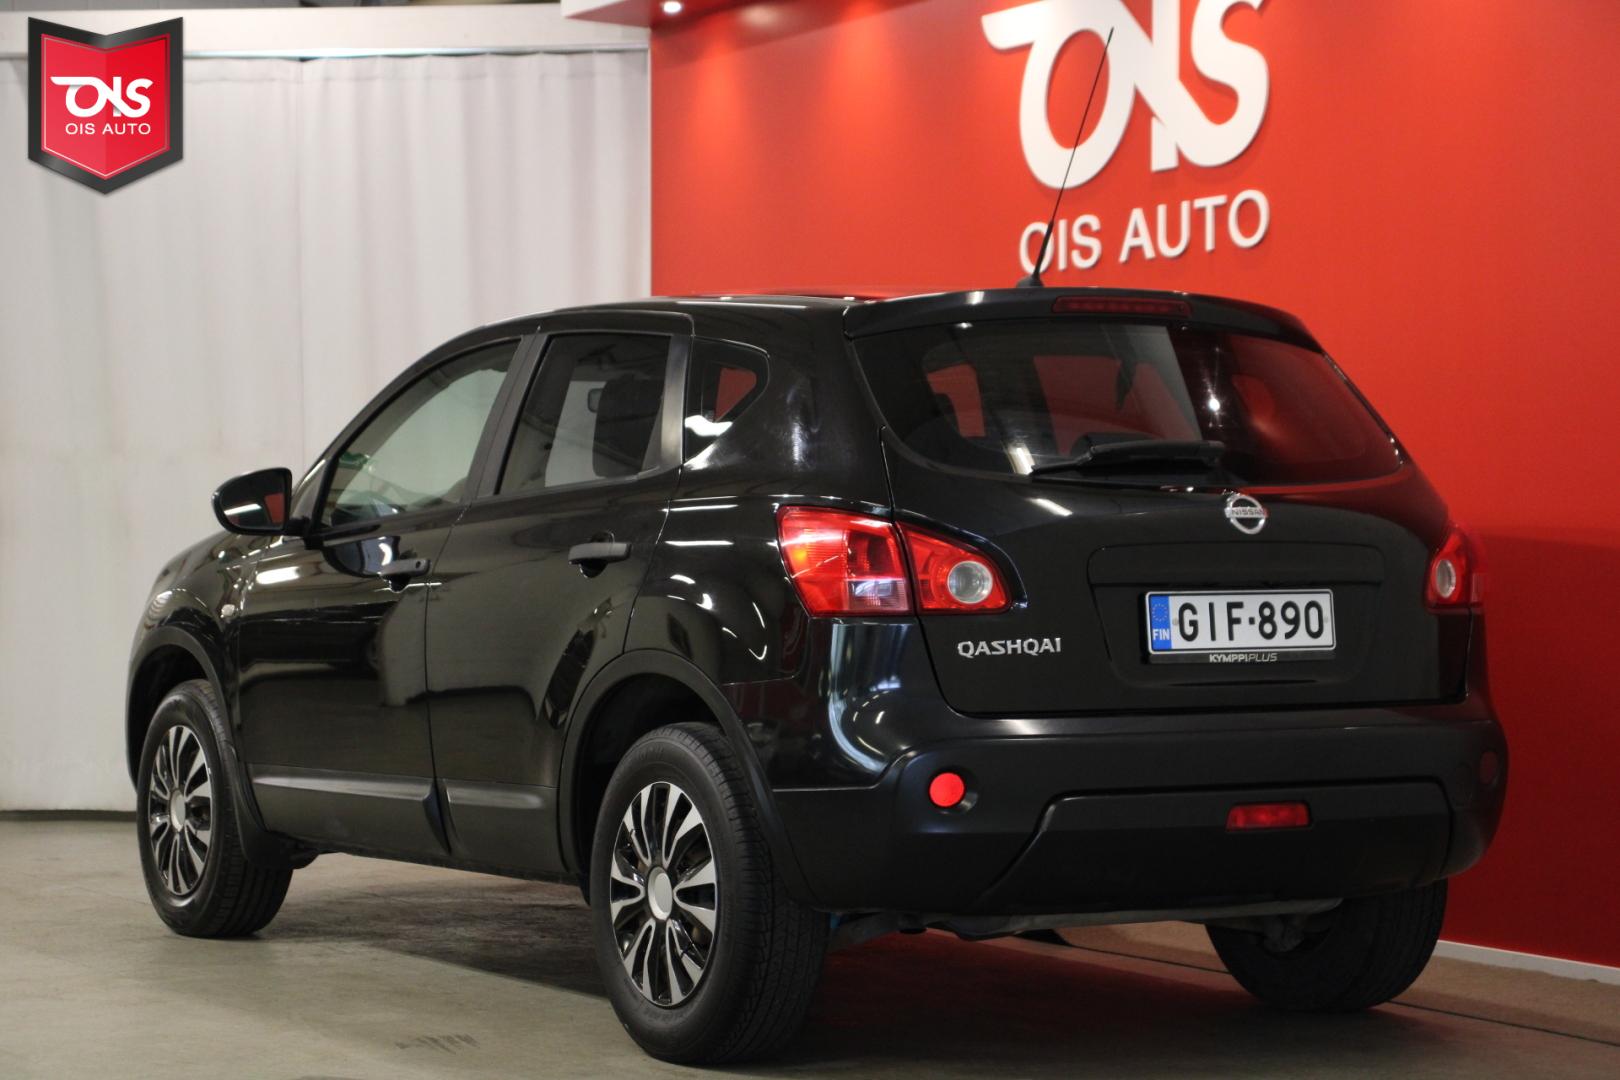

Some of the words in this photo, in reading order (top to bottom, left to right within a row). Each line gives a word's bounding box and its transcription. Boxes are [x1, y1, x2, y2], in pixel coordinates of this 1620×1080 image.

[1019, 214, 1101, 275] OIS
[1118, 189, 1270, 264] AUTO
[1152, 628, 1170, 641] FIN
[957, 637, 1062, 658] QASHQAI
[1209, 652, 1278, 663] KYMPPIPLUS
